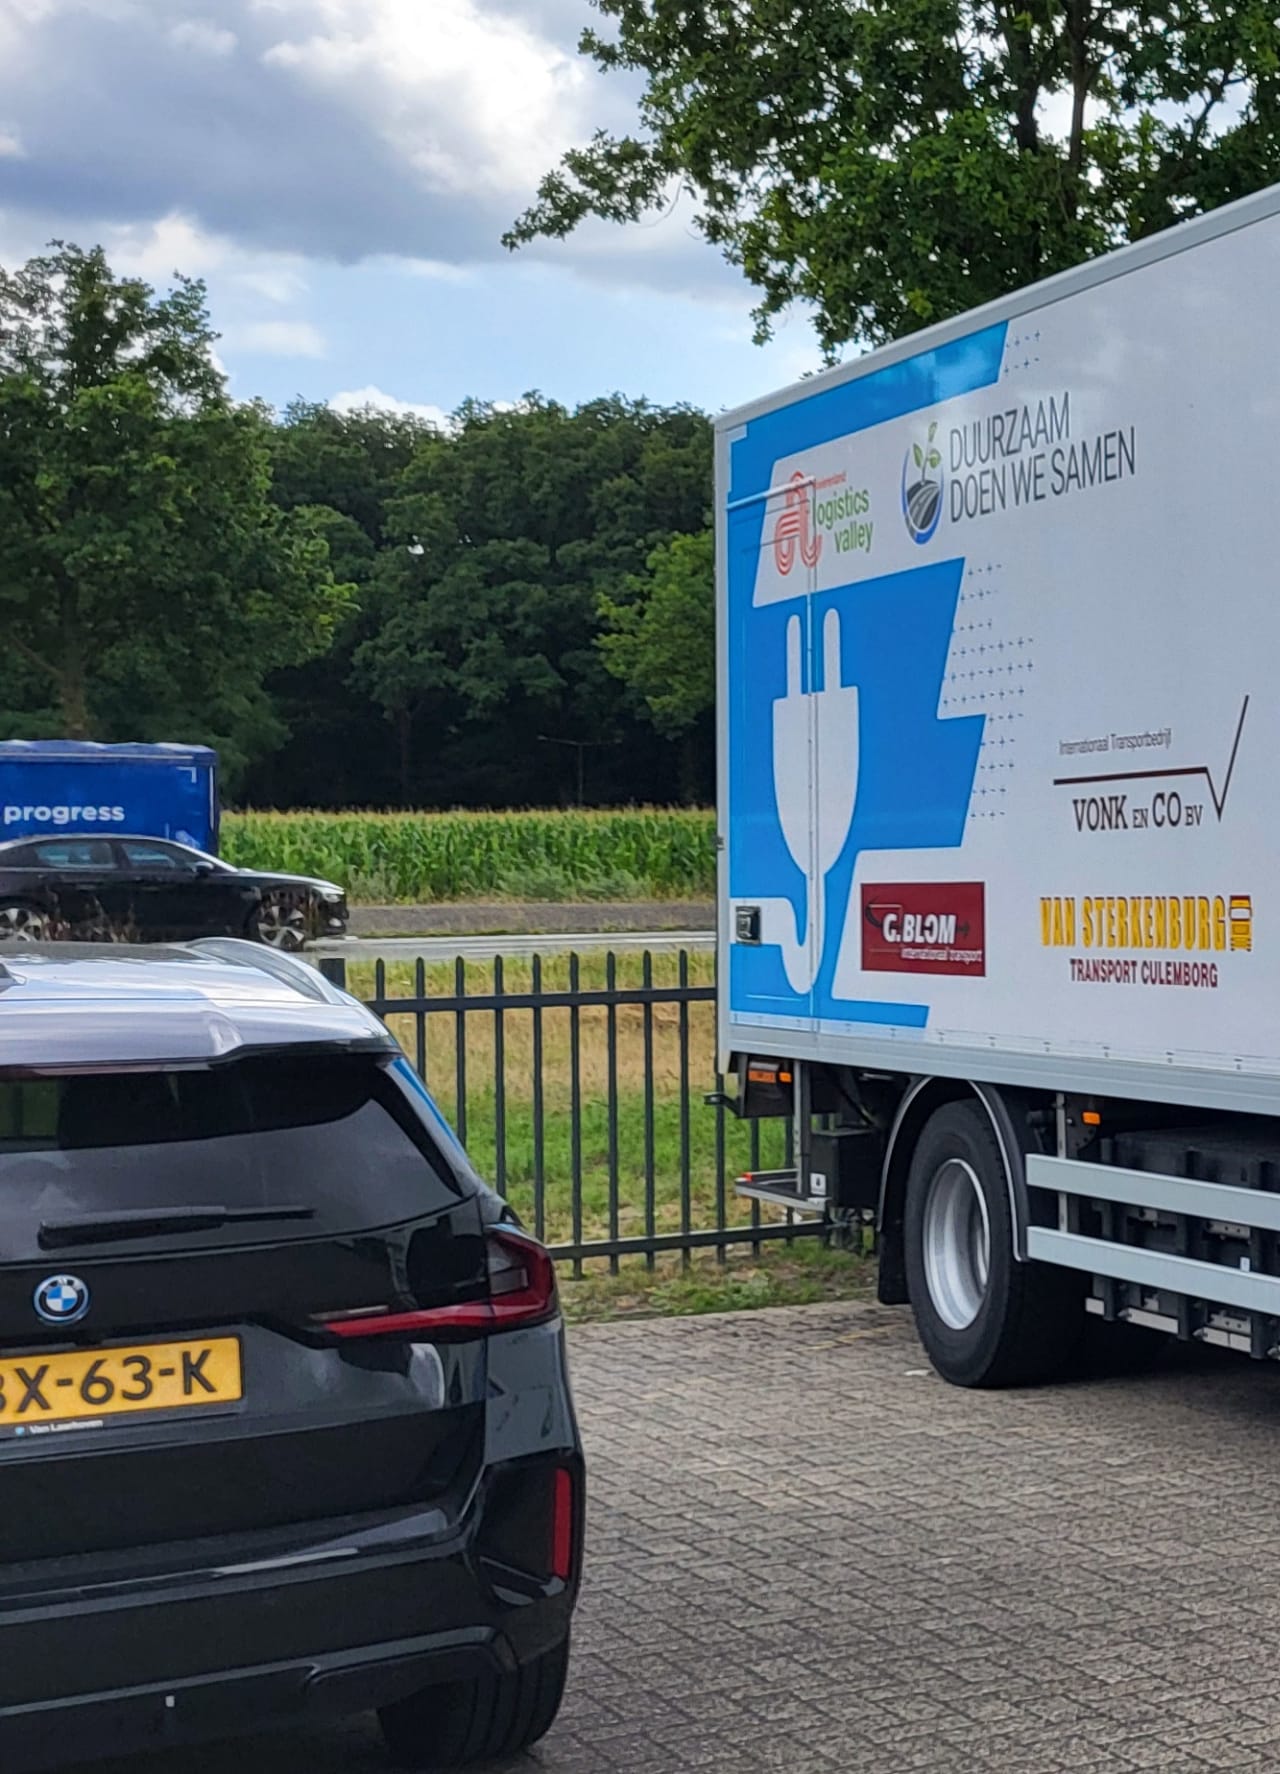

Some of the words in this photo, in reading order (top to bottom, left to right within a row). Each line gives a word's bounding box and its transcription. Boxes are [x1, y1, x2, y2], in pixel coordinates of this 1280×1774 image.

[949, 391, 1071, 472] DUURZAAM
[950, 471, 1005, 523] DOEN
[1011, 453, 1048, 506] WE
[1051, 426, 1137, 495] SAMEN
[833, 521, 874, 554] valley
[4, 805, 125, 824] progress
[1072, 794, 1129, 832] VONK
[1132, 807, 1149, 829] EN
[1151, 791, 1182, 828] CO
[1184, 804, 1204, 827] BV
[1039, 896, 1076, 948] VAN
[1082, 895, 1227, 951] STERKENBURG
[1069, 958, 1138, 985] TRANSPORT
[1141, 960, 1219, 988] CULEMBORG
[0, 1350, 217, 1413] X-63-K
